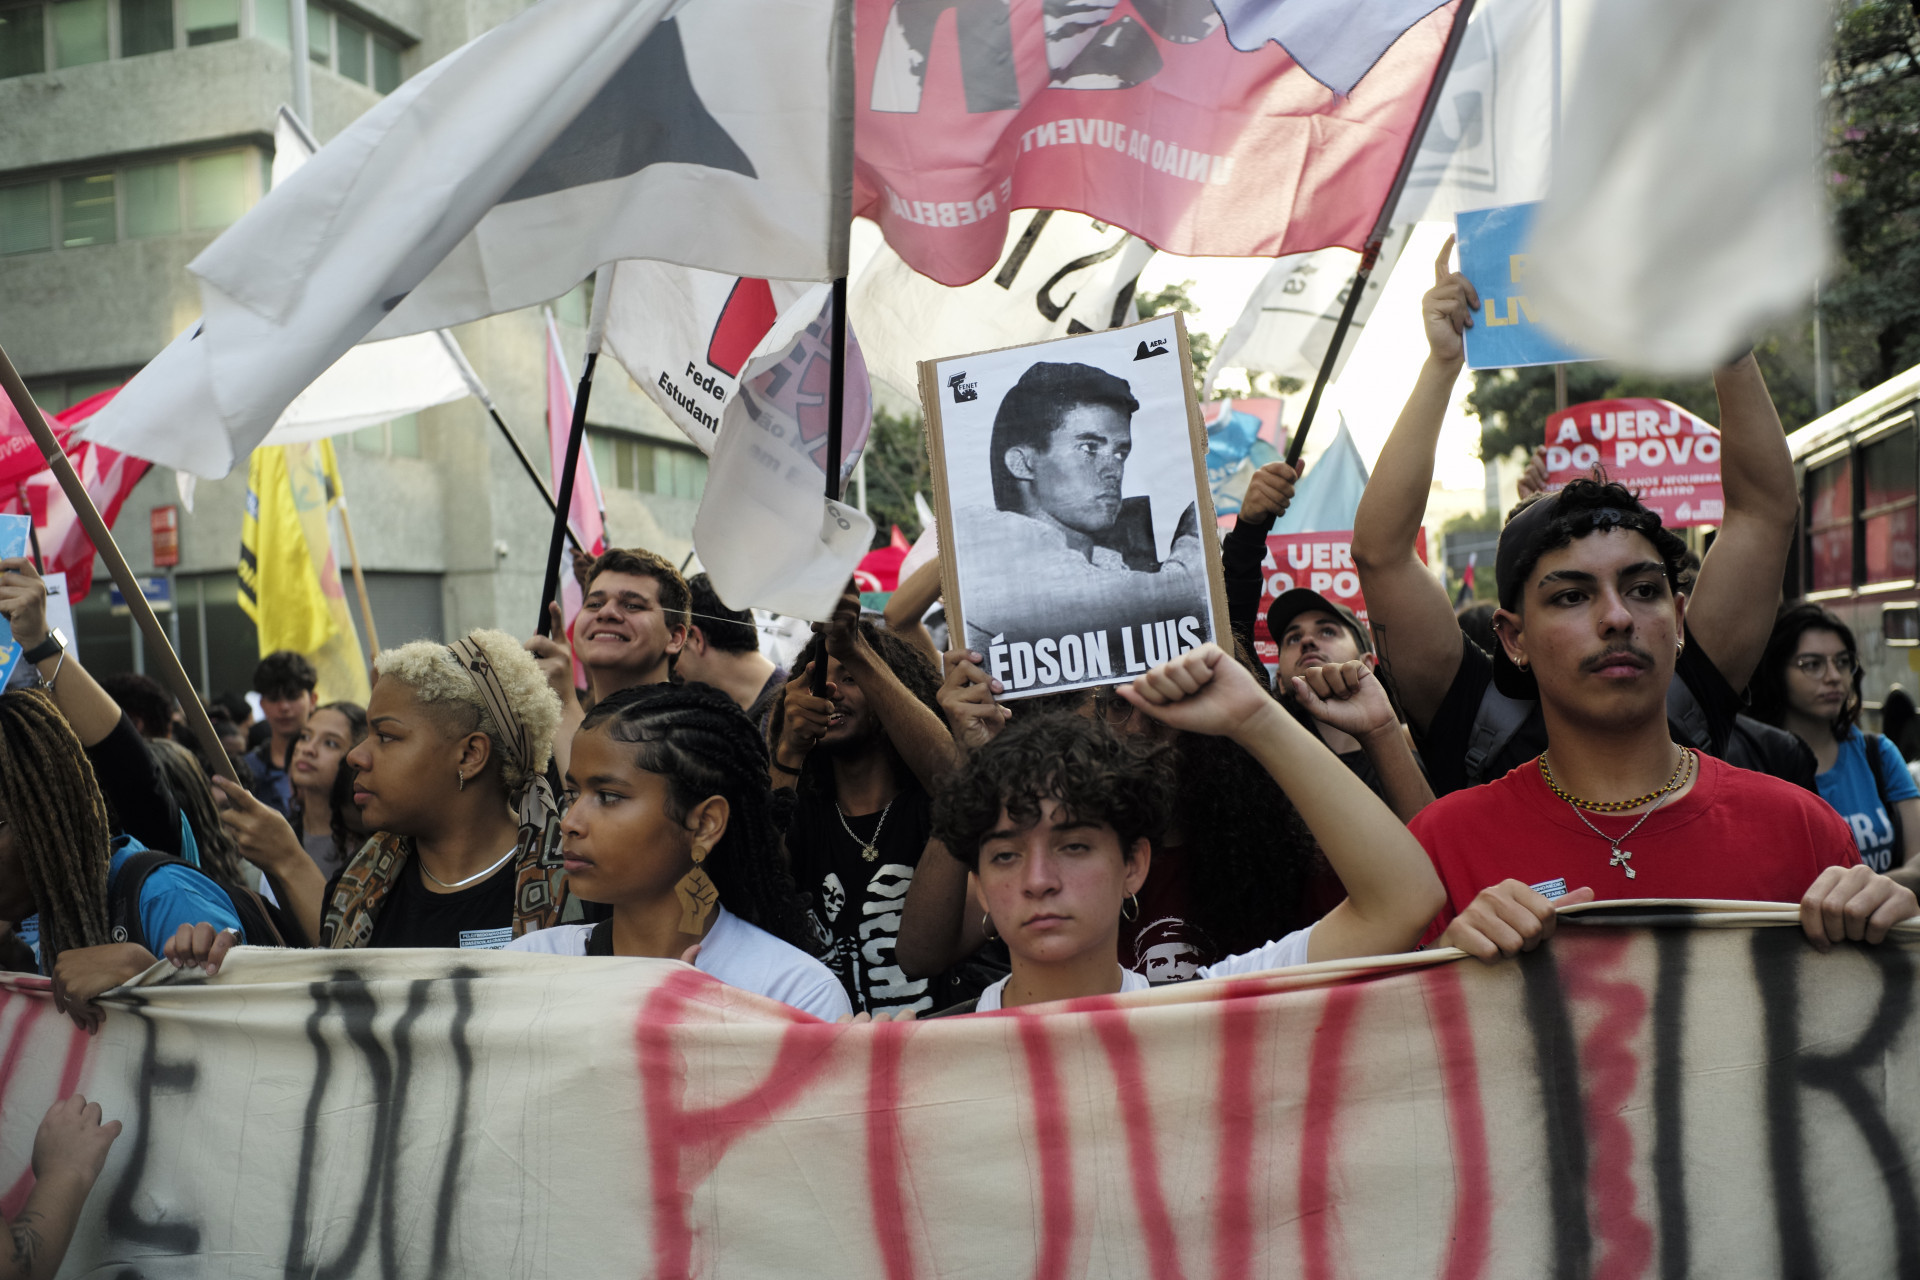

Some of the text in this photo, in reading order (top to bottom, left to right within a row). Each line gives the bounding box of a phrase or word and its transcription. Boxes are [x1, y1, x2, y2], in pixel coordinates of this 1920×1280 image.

[1149, 338, 1168, 348] AERJ
[685, 360, 728, 404] Fede
[958, 381, 978, 391] FENET
[1556, 417, 1582, 444] A
[1591, 410, 1681, 441] UERJ
[1546, 436, 1721, 472] DO POVO
[989, 616, 1202, 690] ÉDSON LUIS
[1844, 808, 1894, 851] RJ
